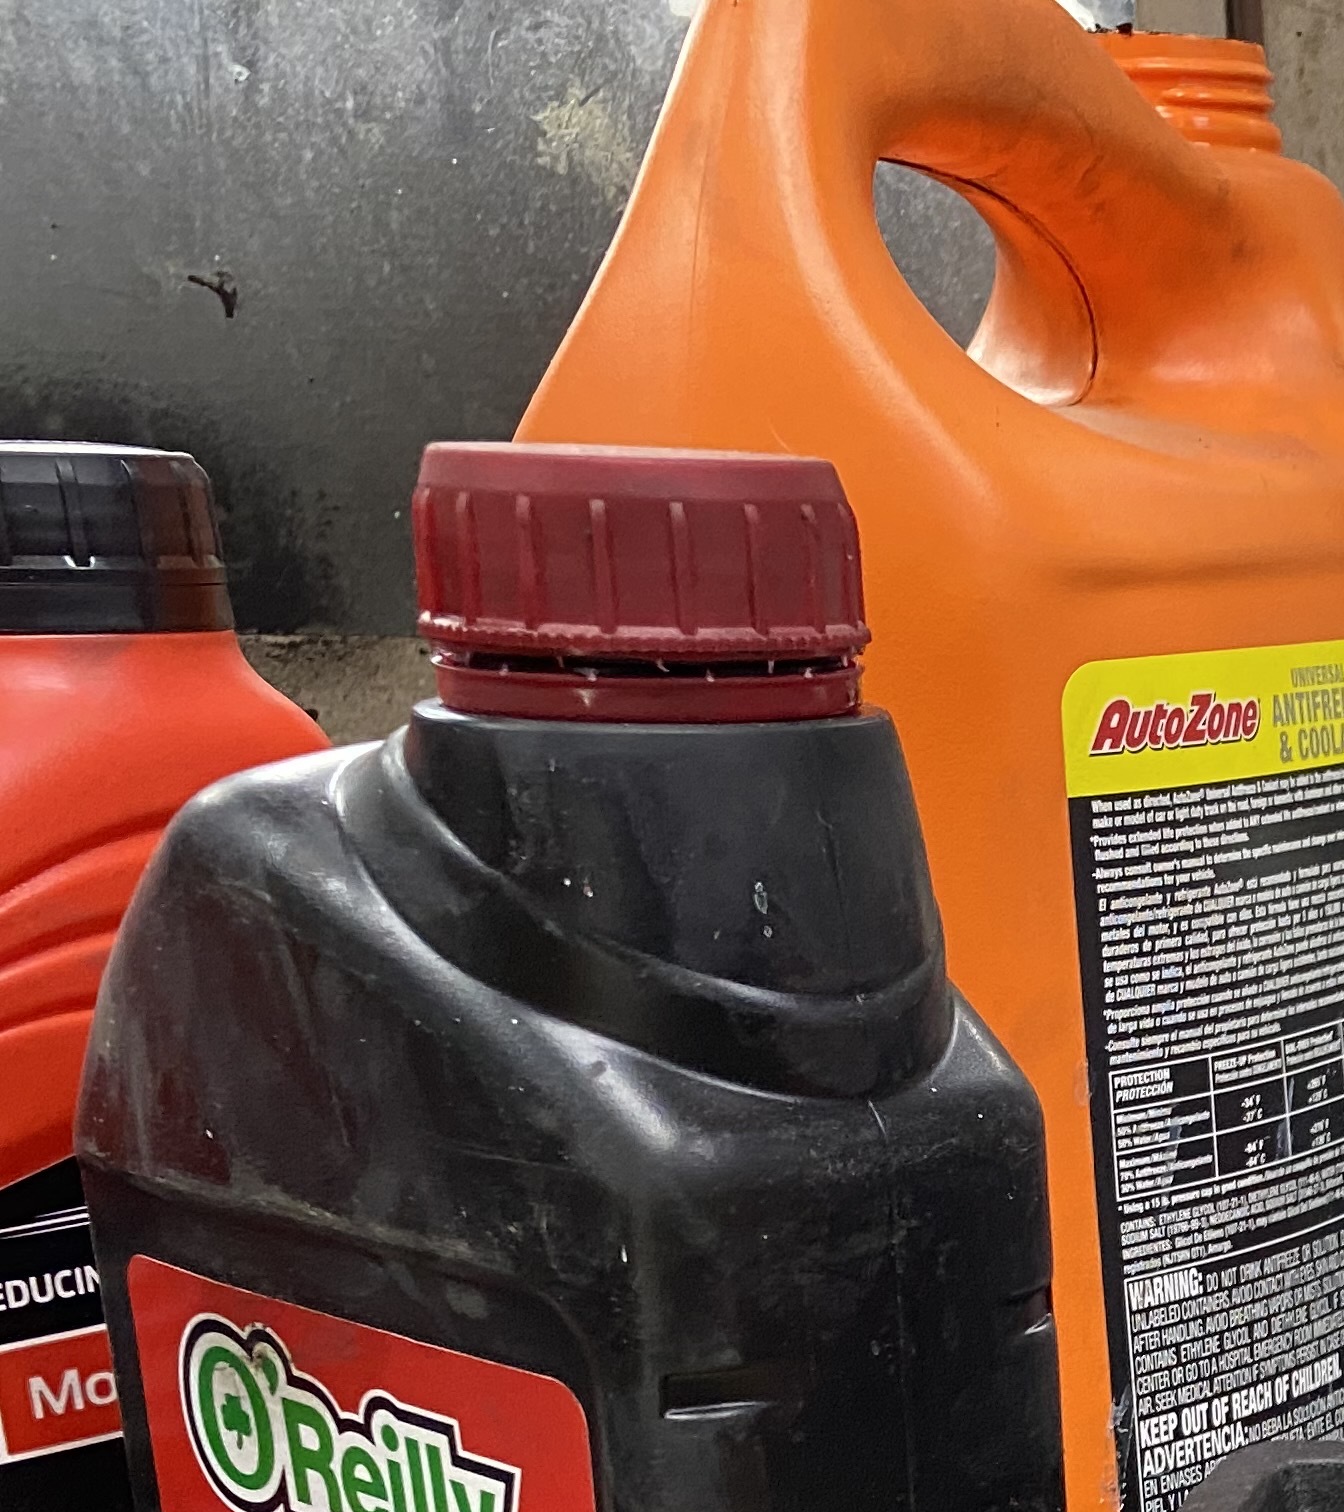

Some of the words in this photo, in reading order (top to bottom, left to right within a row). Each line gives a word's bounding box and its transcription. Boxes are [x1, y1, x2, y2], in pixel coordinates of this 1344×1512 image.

[1089, 692, 1260, 754] AutoZone
[1279, 731, 1293, 763] &
[1113, 1067, 1171, 1090] PROTECTION
[1115, 1080, 1174, 1104] PROTECCIÓN
[1128, 1267, 1204, 1312] WARNING:
[1206, 1272, 1219, 1293] DO
[1221, 1266, 1238, 1288] NOT
[1239, 1259, 1263, 1283] DRINK
[1131, 1303, 1181, 1333] UNLABELED
[1133, 1328, 1162, 1355] AFTER
[1134, 1346, 1178, 1376] CONTAINS
[1179, 1335, 1221, 1364] ETHYLENE
[1253, 1319, 1270, 1340] AND
[1135, 1370, 1171, 1396] CENTER
[1171, 1366, 1186, 1387] OR
[1185, 1362, 1199, 1381] GO
[1198, 1358, 1211, 1379] TO
[1140, 1411, 1178, 1448] KEEP
[1181, 1401, 1209, 1437] OUT
[1211, 1395, 1230, 1428] OF
[1232, 1380, 1273, 1422] REACH
[1274, 1373, 1290, 1406] OF
[1290, 1351, 1343, 1399] CHILDREN.
[1155, 1388, 1178, 1412] SEEK
[1142, 1421, 1249, 1478] ADVERTENCIA:
[1144, 1476, 1159, 1499] EN
[1159, 1463, 1204, 1493] ENVASES
